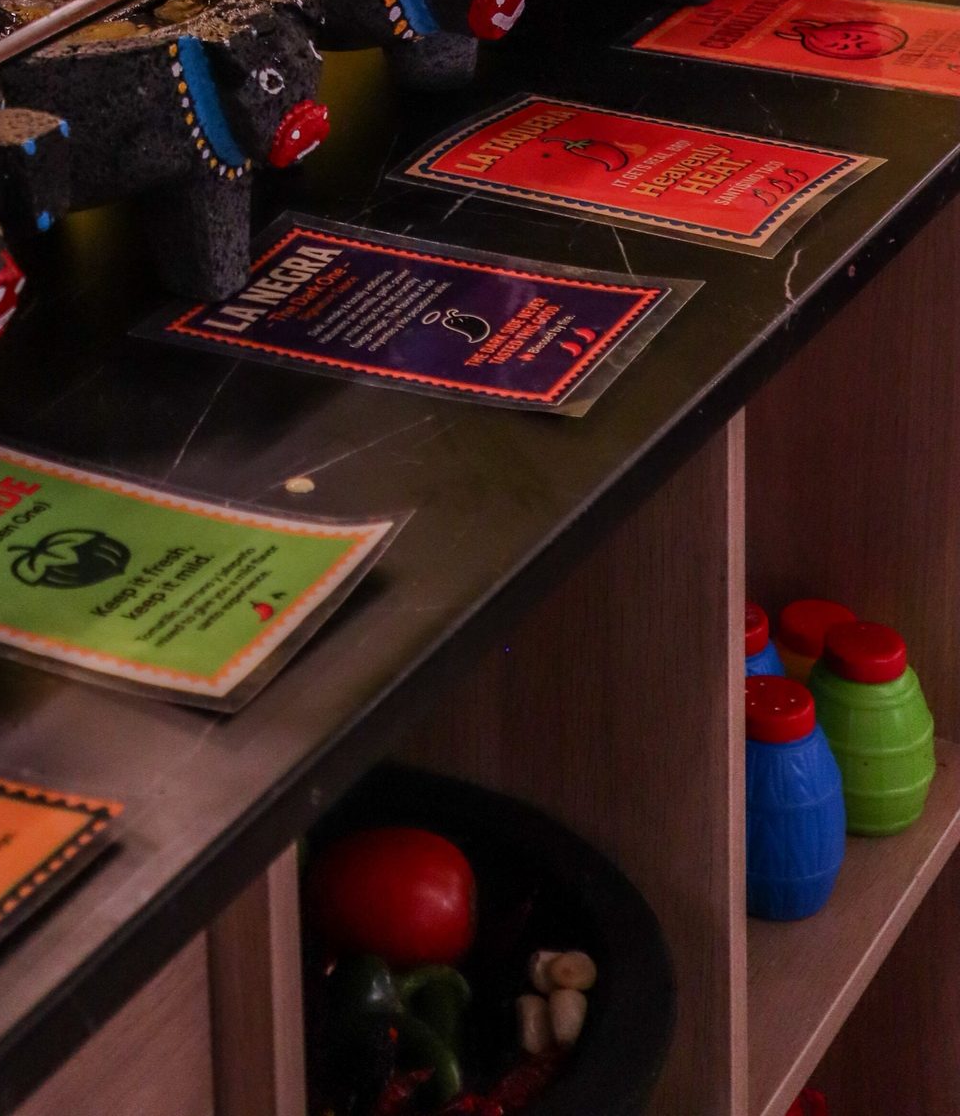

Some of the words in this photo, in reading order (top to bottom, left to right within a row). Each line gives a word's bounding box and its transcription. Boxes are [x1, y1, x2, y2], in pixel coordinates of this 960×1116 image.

[478, 110, 575, 155] TAQUERA
[454, 152, 504, 172] LA
[610, 178, 630, 188] IT
[621, 163, 652, 180] GETS
[630, 143, 733, 197] Heavenly
[674, 156, 751, 195] HEAT.
[202, 305, 267, 332] LA
[239, 245, 342, 304] NEGRA
[266, 305, 299, 321] The
[288, 284, 325, 305] Dark
[314, 267, 347, 285] One
[463, 352, 489, 366] THE
[479, 333, 509, 353] DARK
[499, 317, 526, 334] SIDE
[516, 297, 547, 319] NEVER
[488, 339, 524, 364] TASTED
[514, 324, 541, 339] THIS
[526, 331, 557, 353] Blessed
[547, 324, 567, 333] by
[11, 500, 51, 524] One)
[87, 587, 137, 617] Keep
[127, 575, 152, 587] it
[120, 591, 166, 620] keep
[161, 580, 181, 591] it
